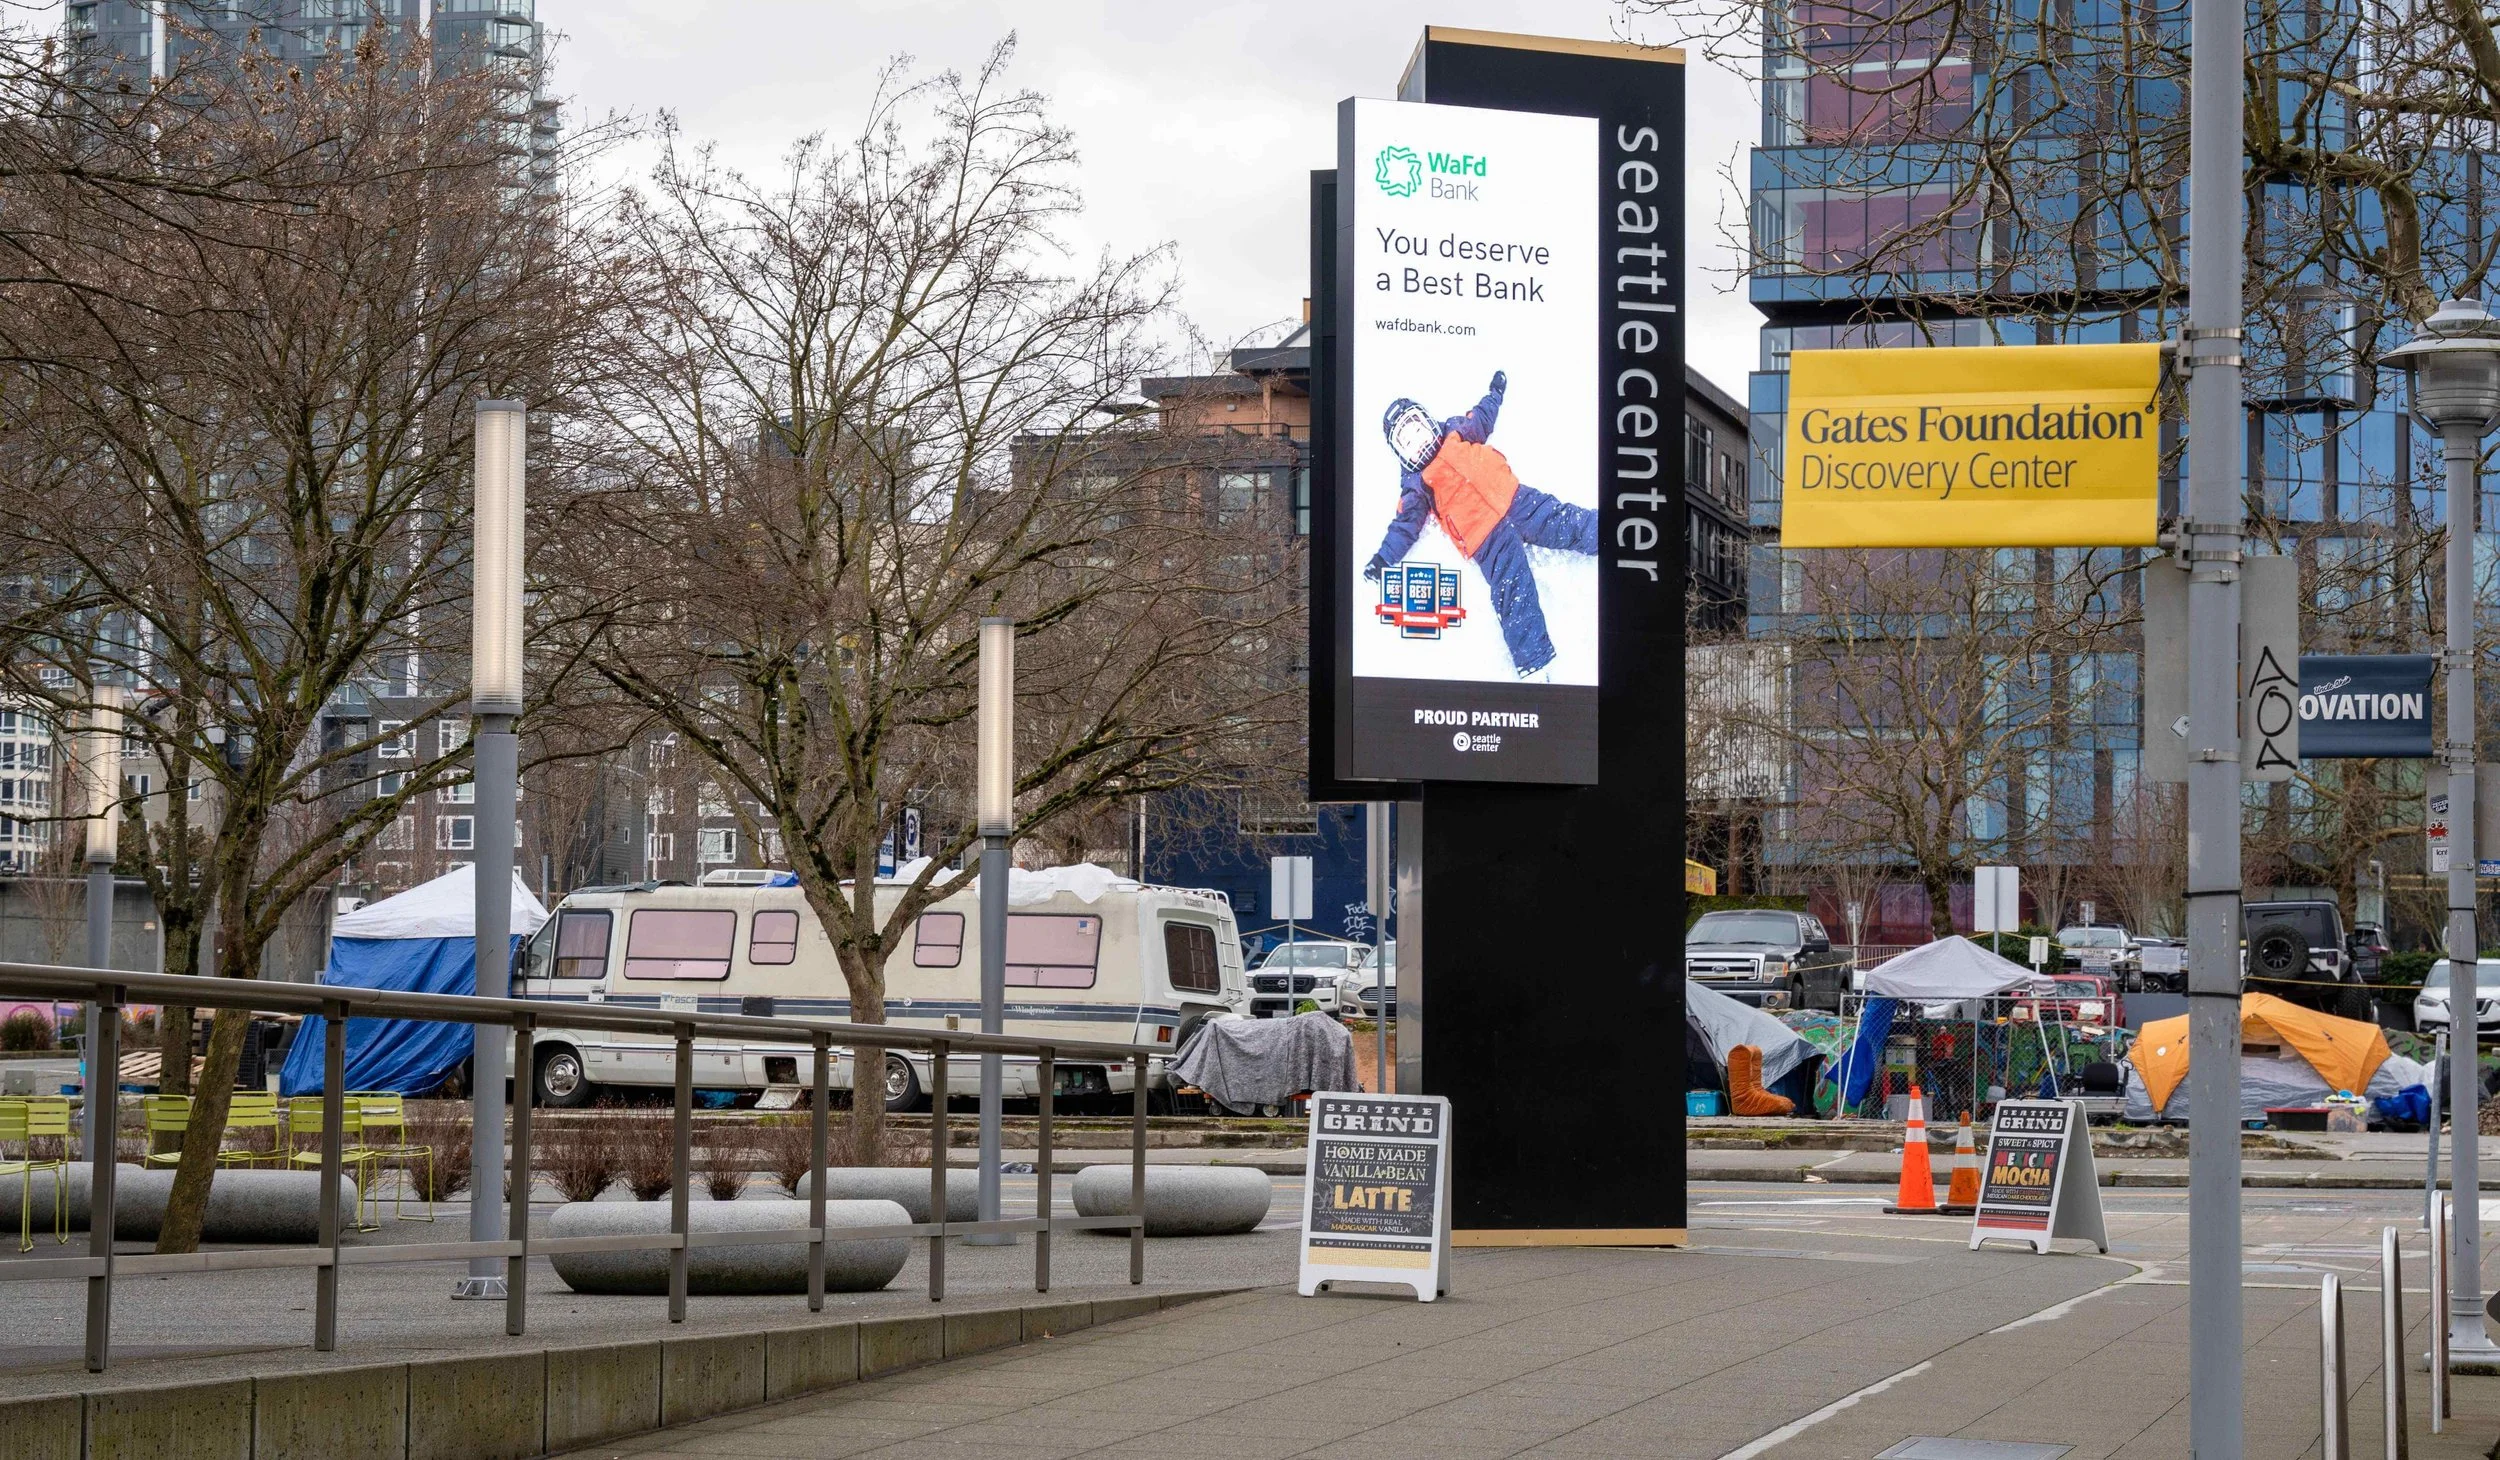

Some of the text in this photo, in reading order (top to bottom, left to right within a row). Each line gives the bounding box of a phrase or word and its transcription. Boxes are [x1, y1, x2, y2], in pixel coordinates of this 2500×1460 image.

[1428, 152, 1487, 177] WaFd
[1431, 178, 1479, 201] Bank
[1376, 227, 1550, 265] You deserve
[1376, 267, 1545, 302] a Best Bank
[1375, 319, 1476, 337] wafdbank.com
[1801, 402, 2143, 444] Gates Foundation
[1801, 452, 2077, 500] Discovery Center
[1409, 584, 1432, 599] BEST
[1414, 709, 1539, 728] PROUD PARTNER
[1472, 734, 1501, 744] seattle
[1472, 743, 1499, 752] center
[1343, 916, 1376, 932] ICE
[1326, 1104, 1432, 1116] SEATTLE
[2003, 1109, 2063, 1117] SEATTLE
[1323, 1114, 1433, 1133] GRIND
[1999, 1117, 2063, 1130] GRIND
[1998, 1138, 2028, 1147] SWEET
[2032, 1139, 2056, 1148] SPICY
[1325, 1146, 1427, 1162] HOME MADE
[1991, 1166, 2051, 1186] MOCHA
[1333, 1184, 1413, 1212] LATTE
[1330, 1223, 1377, 1232] MADAGASCAR
[1340, 1216, 1361, 1224] MADE
[1361, 1217, 1383, 1225] WITH
